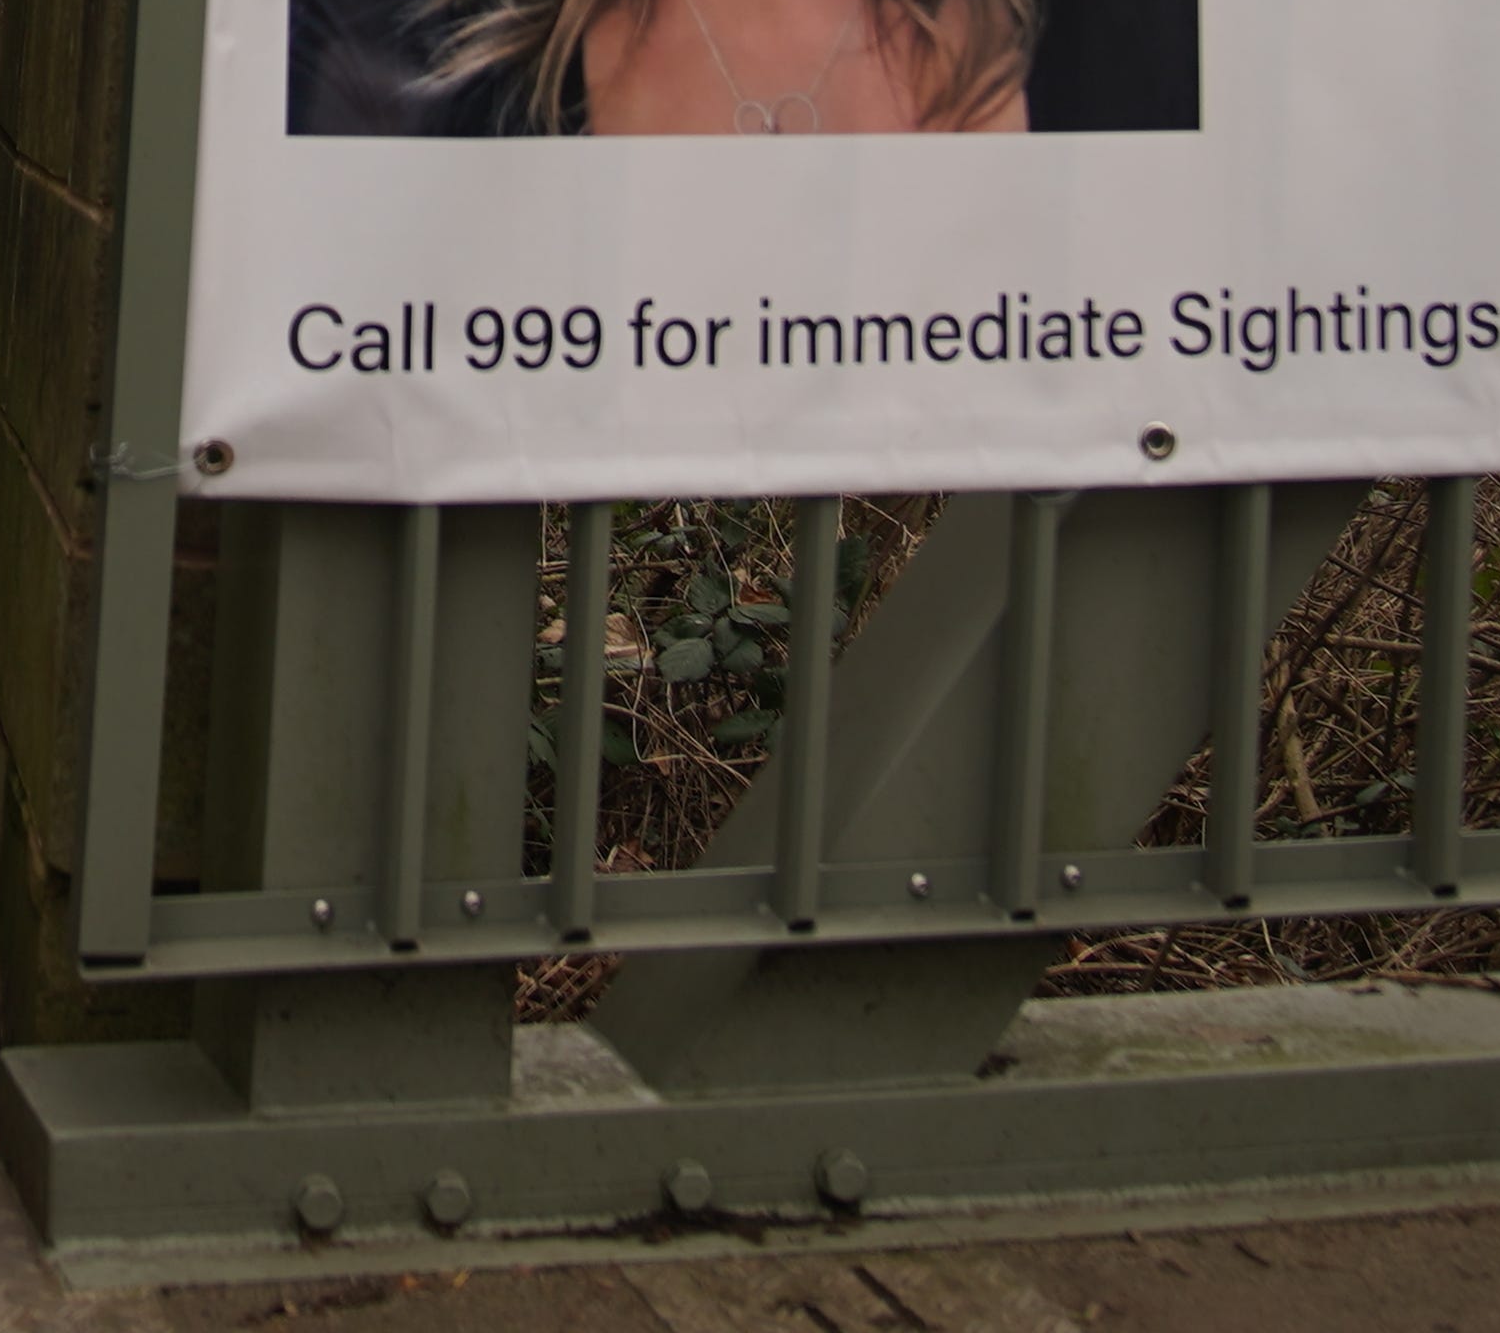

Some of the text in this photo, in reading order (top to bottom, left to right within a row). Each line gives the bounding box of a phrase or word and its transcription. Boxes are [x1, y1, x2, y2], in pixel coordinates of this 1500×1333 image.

[287, 300, 435, 373] Call
[464, 305, 603, 372] 999
[627, 297, 733, 369] for
[759, 292, 1145, 366] immediate
